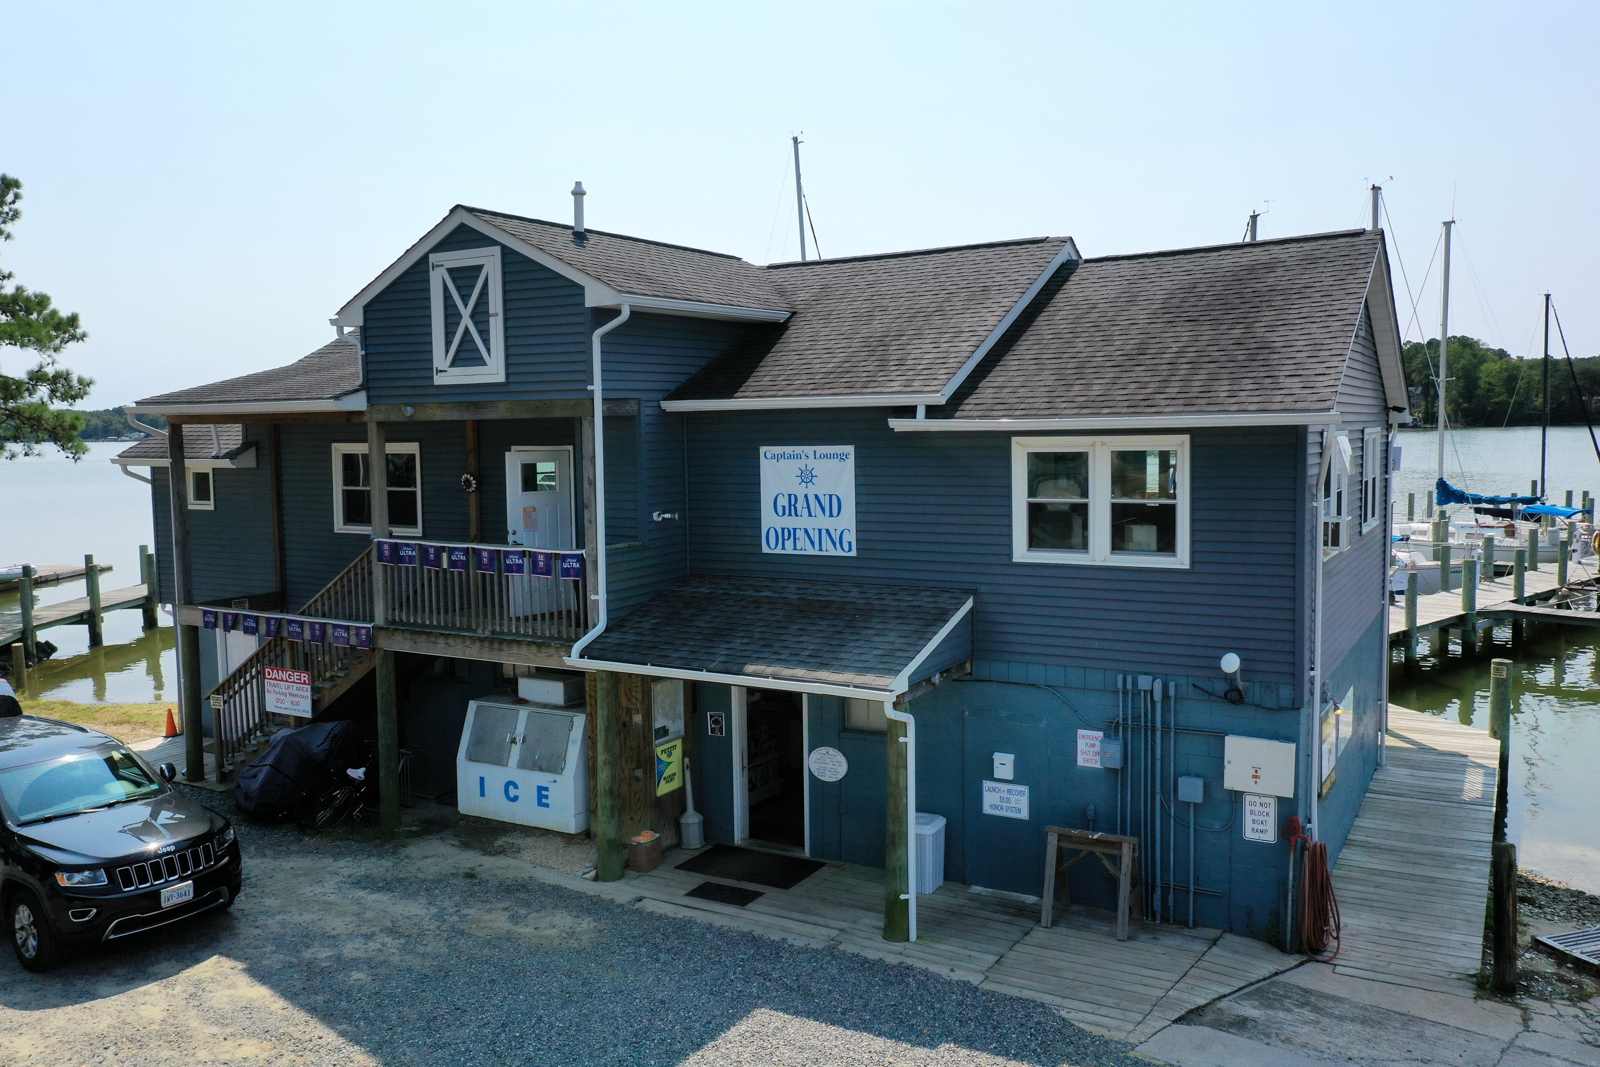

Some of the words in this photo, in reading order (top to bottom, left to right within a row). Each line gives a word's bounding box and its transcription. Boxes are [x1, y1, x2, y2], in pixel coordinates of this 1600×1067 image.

[764, 450, 809, 462] Captain's
[814, 450, 850, 462] Lounge
[773, 493, 842, 518] GRAND
[765, 526, 852, 553] OPENING
[266, 668, 308, 683] DANGER
[289, 692, 309, 700] Weekdays
[479, 776, 550, 808] ICE
[1007, 788, 1026, 797] RECOVER
[1005, 806, 1021, 814] SYSTEM
[158, 845, 175, 853] Jeep
